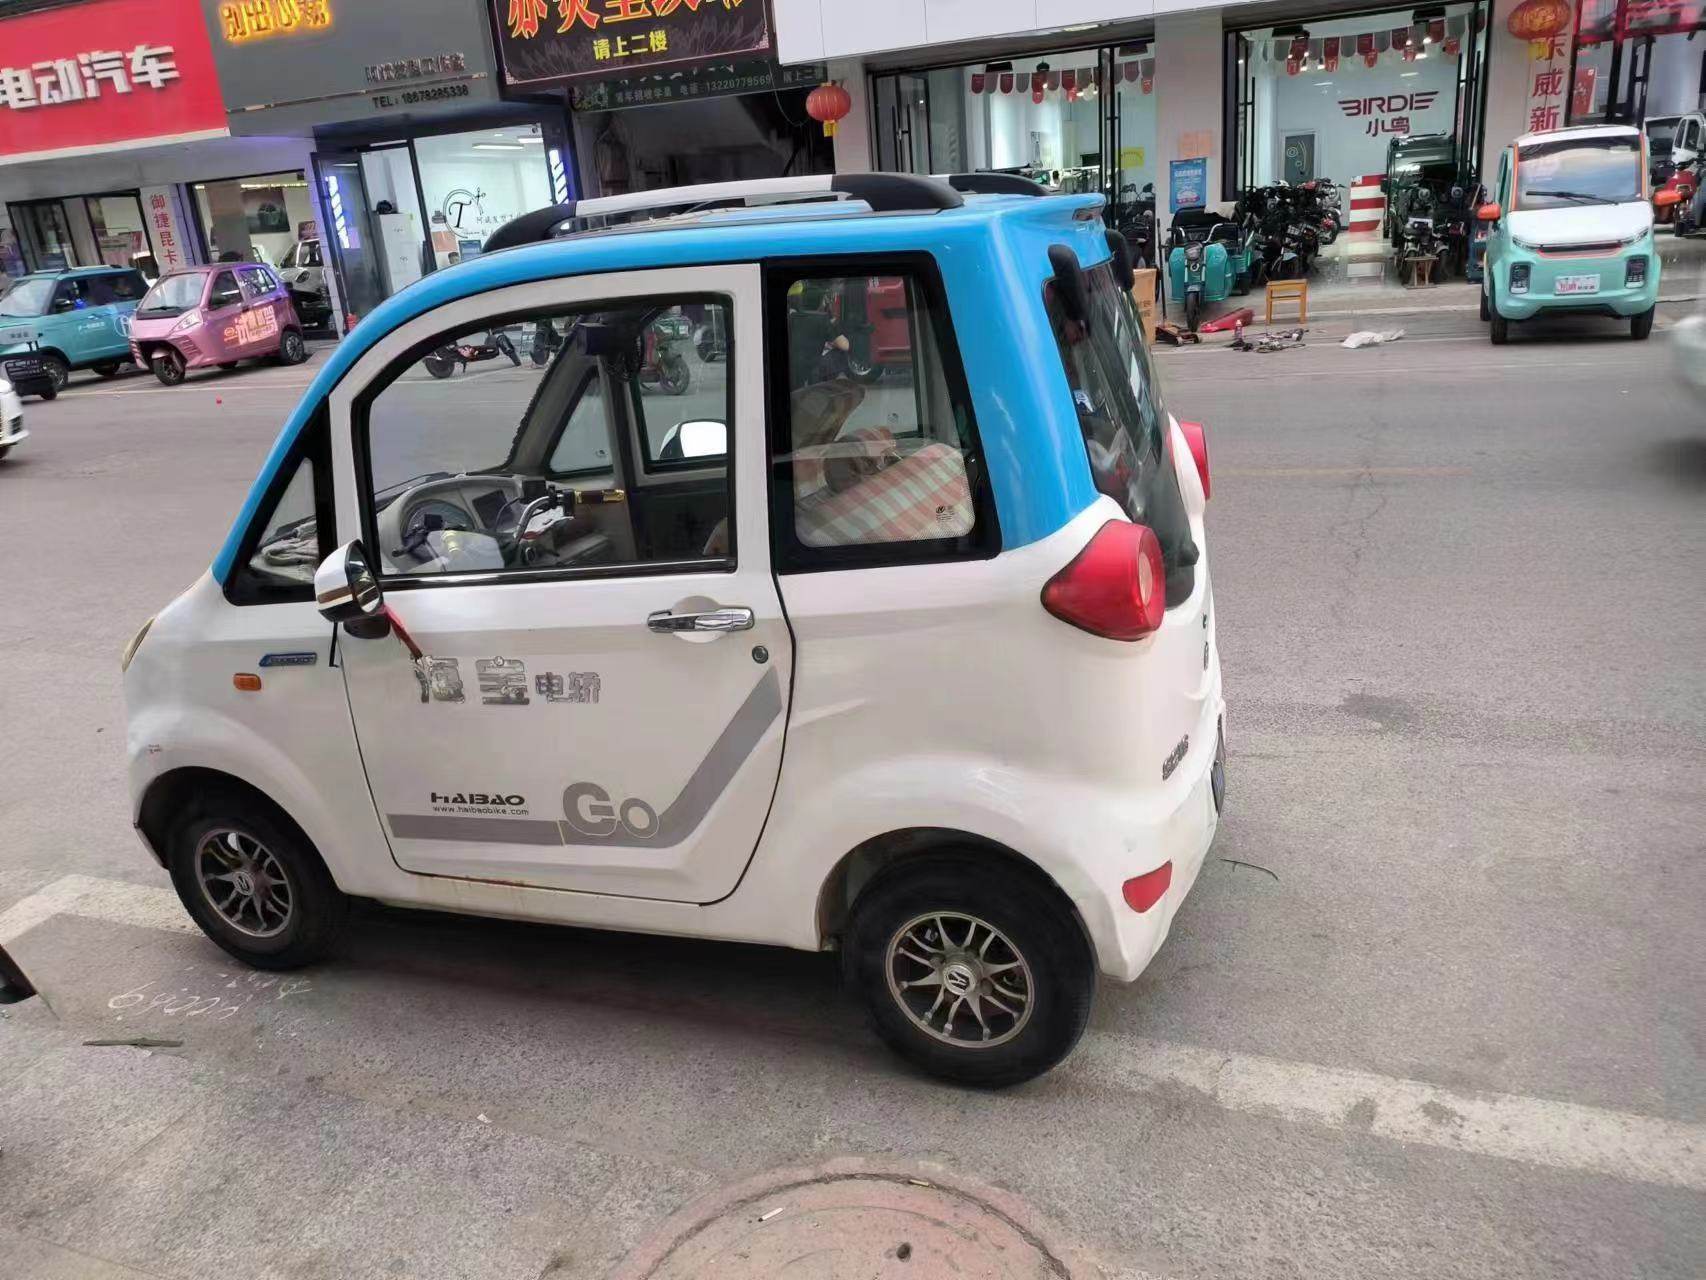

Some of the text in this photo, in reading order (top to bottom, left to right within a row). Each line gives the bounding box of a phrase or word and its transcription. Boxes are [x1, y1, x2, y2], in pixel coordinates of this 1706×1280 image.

[593, 30, 668, 60] 请上二楼
[0, 44, 181, 109] 电动汽车
[1337, 91, 1439, 117] BIRDIE
[1365, 116, 1410, 137] 小鸟
[150, 194, 179, 273] 御捷昆卡
[430, 792, 526, 806] HAIBAO
[432, 805, 530, 816] www.haibaobike.com
[562, 781, 660, 839] Go
